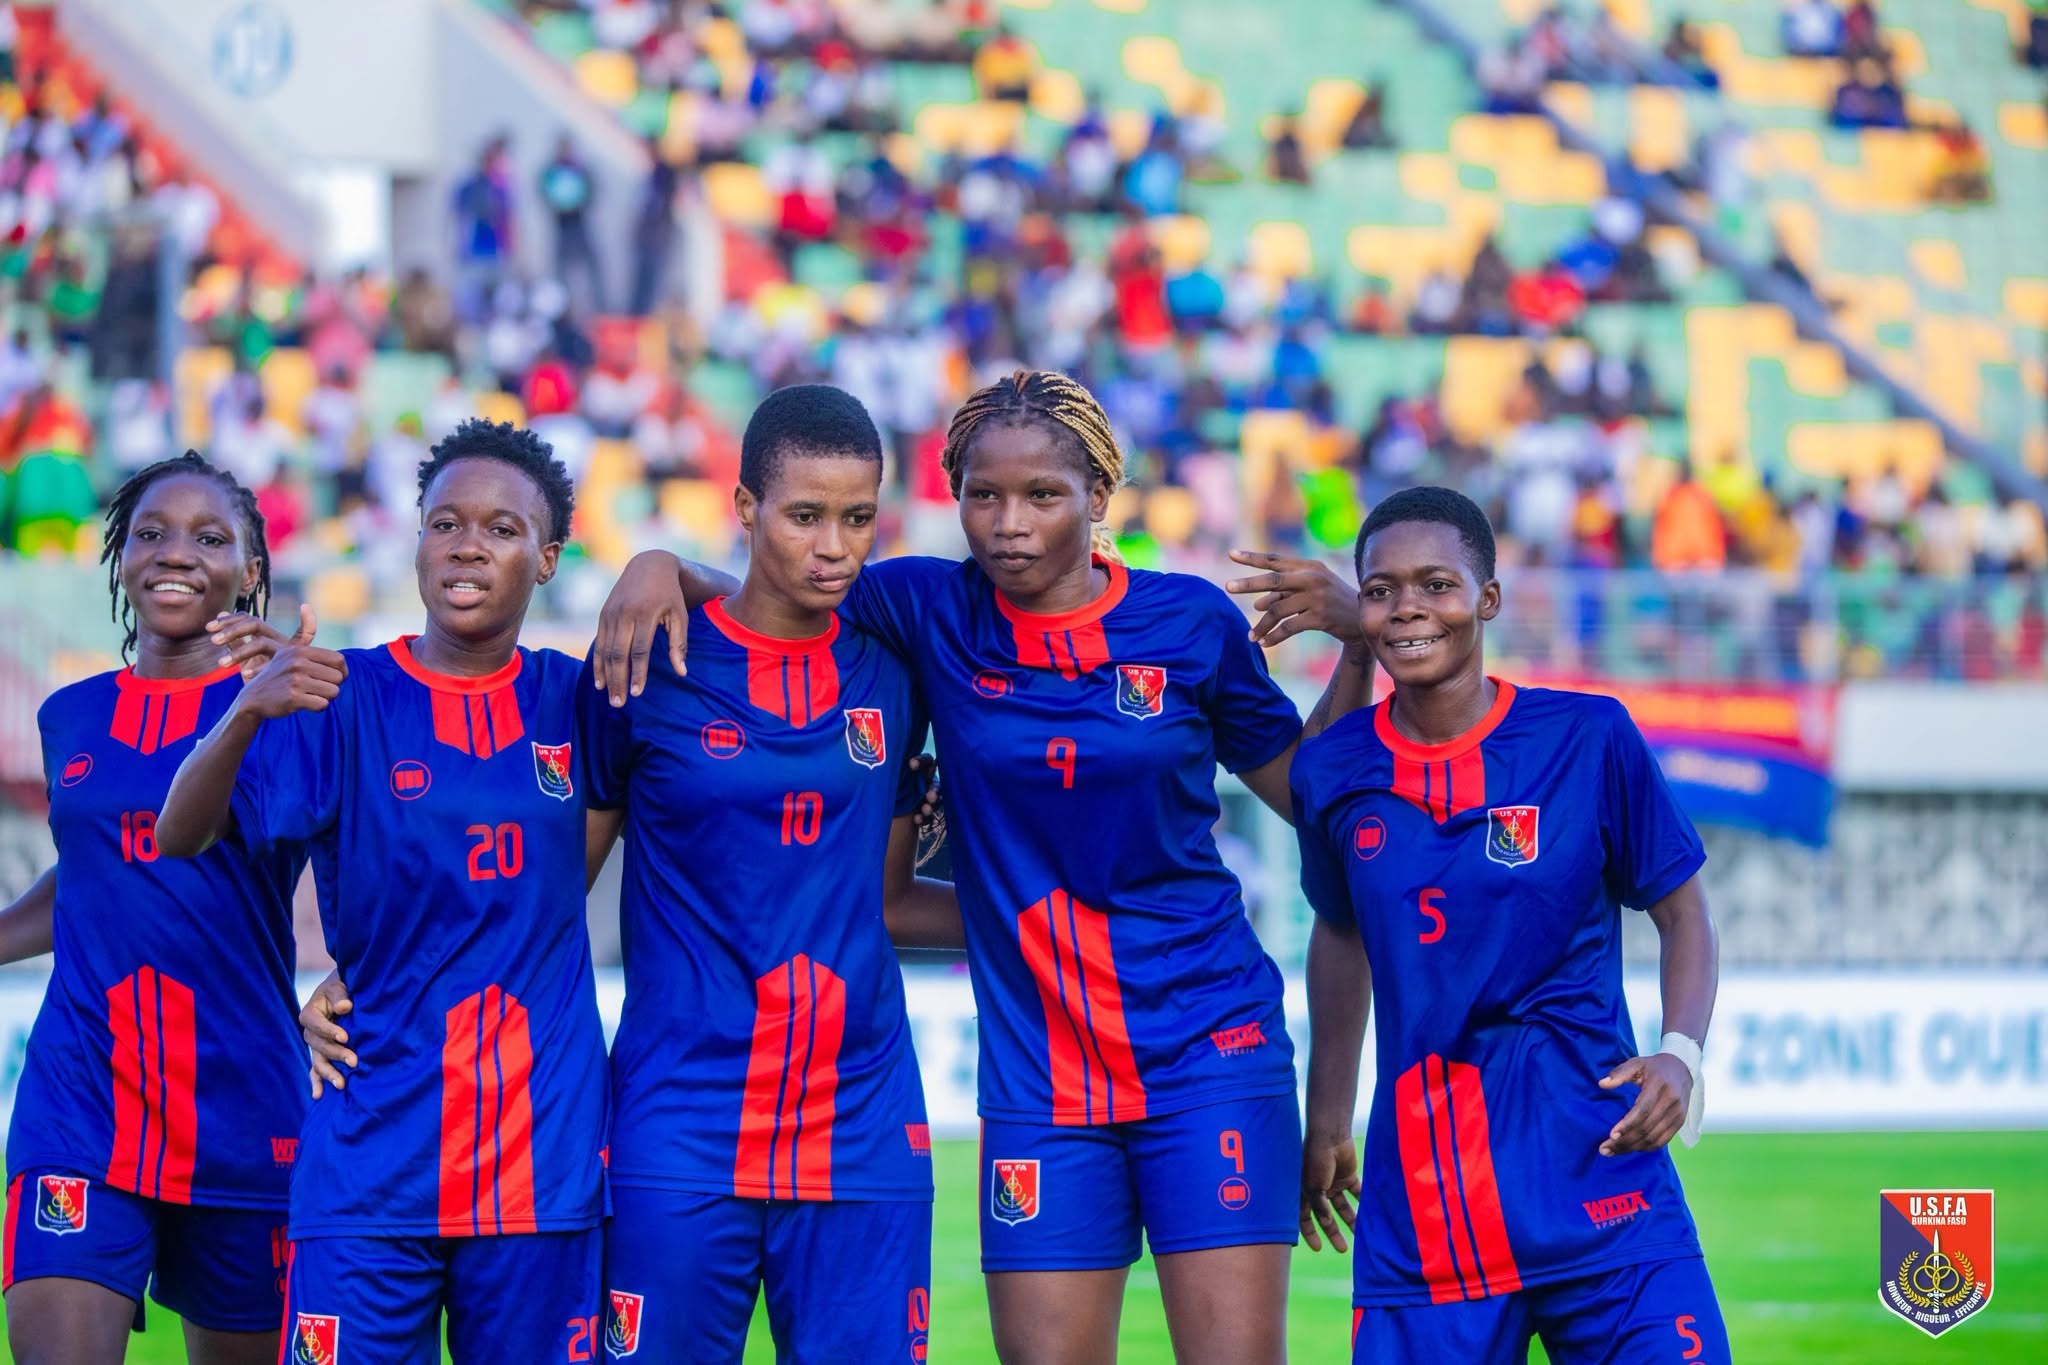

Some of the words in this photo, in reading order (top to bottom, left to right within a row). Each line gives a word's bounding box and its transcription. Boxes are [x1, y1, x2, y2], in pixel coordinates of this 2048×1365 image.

[1045, 737, 1076, 788] 9
[121, 811, 160, 862] 18
[781, 792, 823, 845] 10
[466, 823, 523, 880] 20
[1419, 888, 1446, 943] 5
[1731, 1012, 1902, 1085] ZONE
[1220, 1130, 1244, 1173] 9
[314, 1319, 325, 1327] FA
[908, 1287, 929, 1333] 10
[1676, 1315, 1702, 1360] 5
